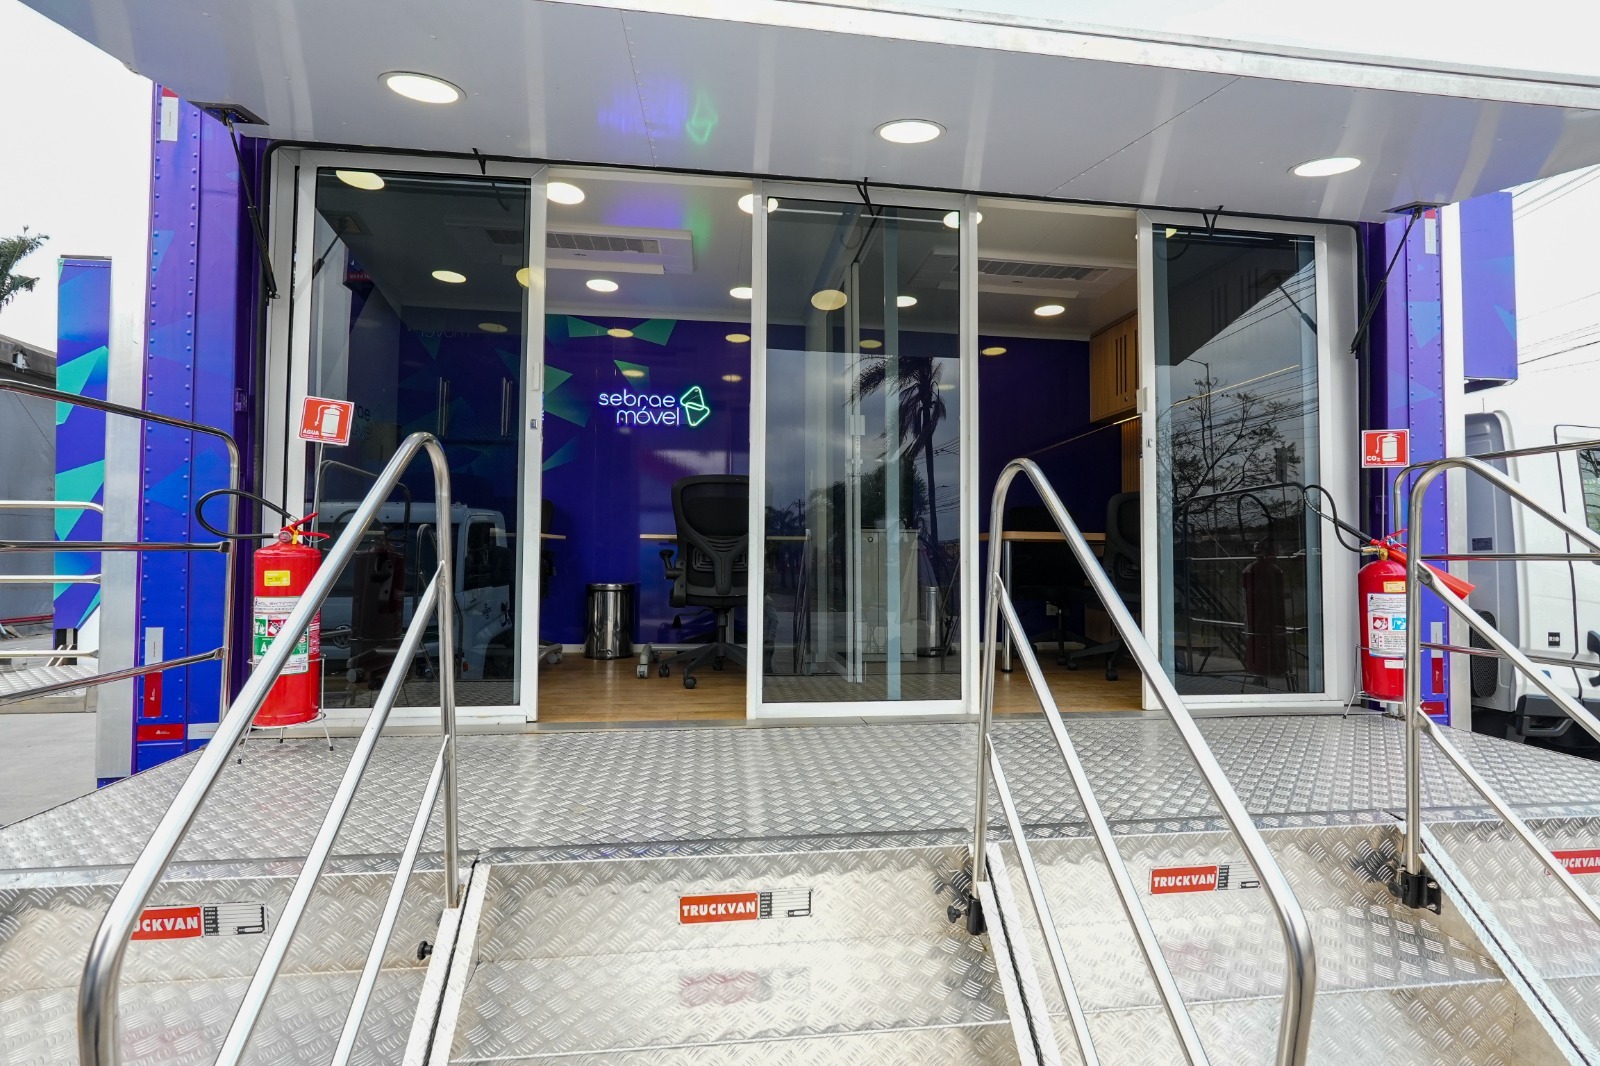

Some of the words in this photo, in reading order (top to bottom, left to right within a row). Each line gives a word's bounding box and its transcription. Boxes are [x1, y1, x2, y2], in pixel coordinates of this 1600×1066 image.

[598, 389, 676, 408] sebrae
[616, 406, 680, 426] móvel
[1558, 857, 1600, 868] UCKVAN
[1153, 873, 1215, 888] TRUCKVAN
[682, 901, 756, 917] TRUCKVAN
[133, 916, 199, 932] UCKVAN
